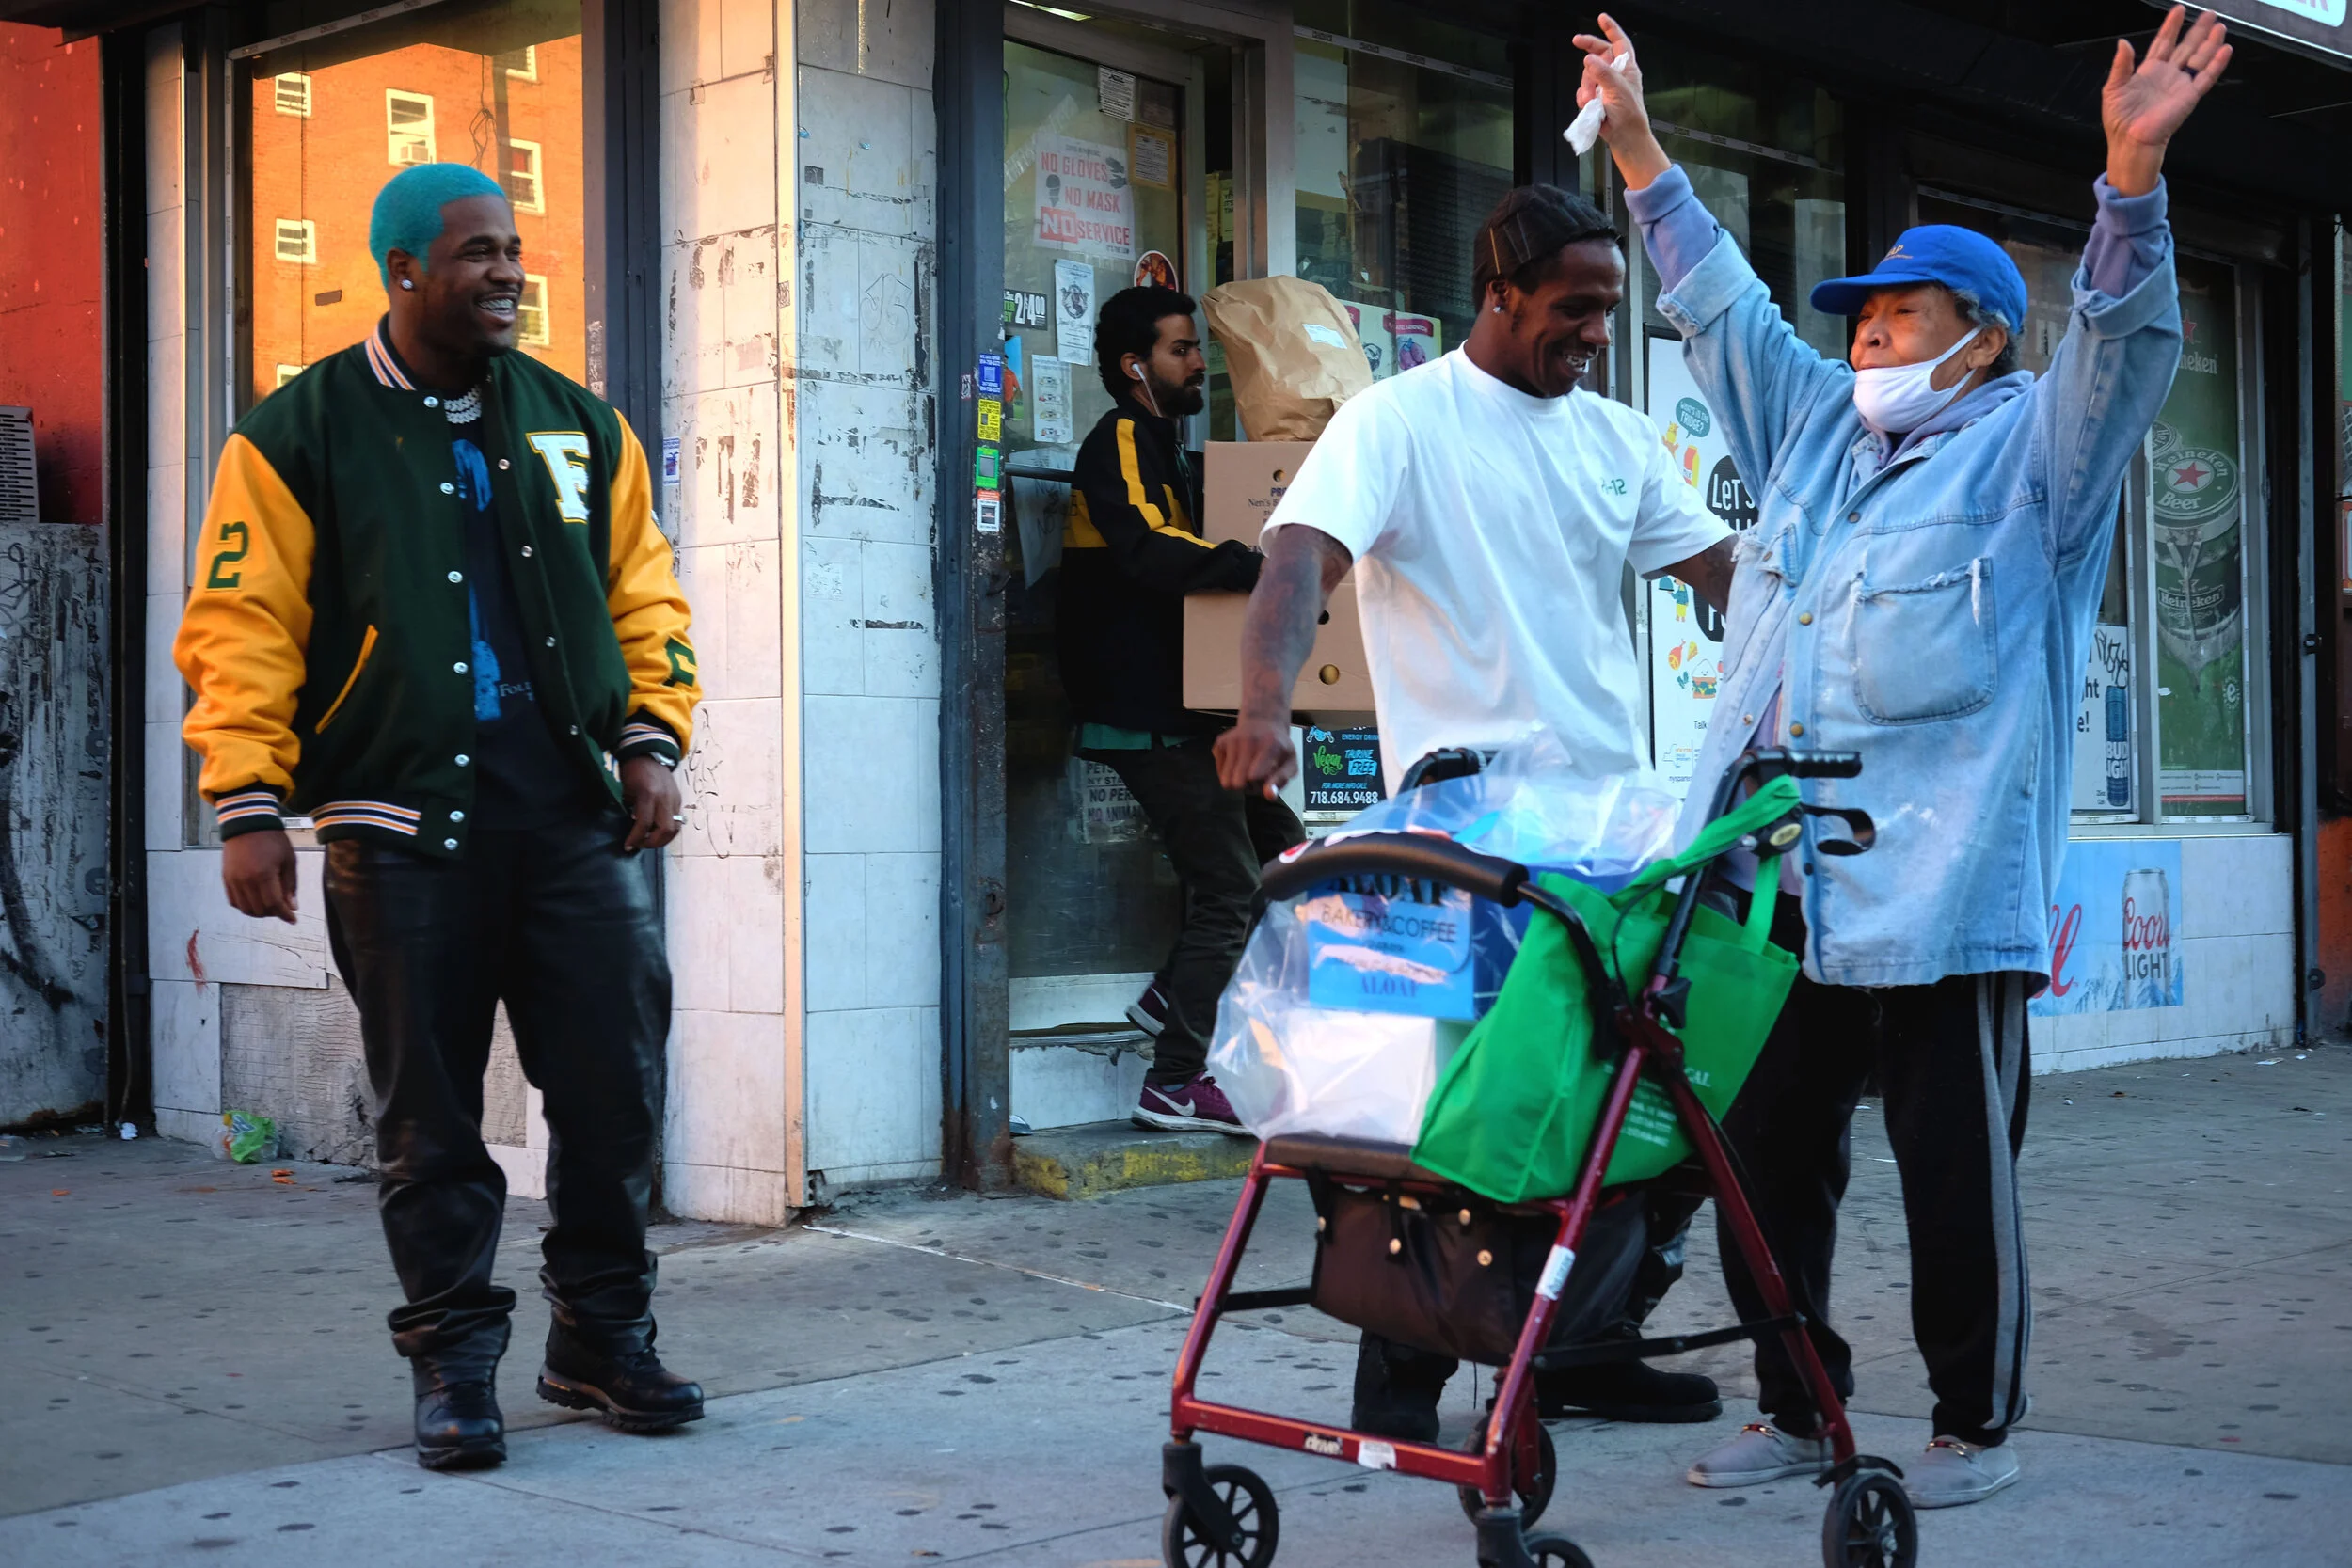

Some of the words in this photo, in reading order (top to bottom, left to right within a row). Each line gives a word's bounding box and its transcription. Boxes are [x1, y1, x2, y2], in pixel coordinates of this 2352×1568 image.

[1041, 152, 1058, 173] NO
[1062, 156, 1108, 182] GLOVES
[1065, 186, 1081, 206] NO
[1087, 190, 1120, 213] MASK
[1041, 212, 1076, 238] NO
[1076, 220, 1130, 245] SERVICE
[2179, 351, 2217, 374] neken
[2153, 451, 2228, 477] Heineken
[2158, 491, 2201, 509] Beer
[206, 520, 250, 592] 2
[1352, 760, 1374, 773] FREE
[1089, 789, 1106, 802] NO
[1310, 791, 1378, 804] 718.684.9488
